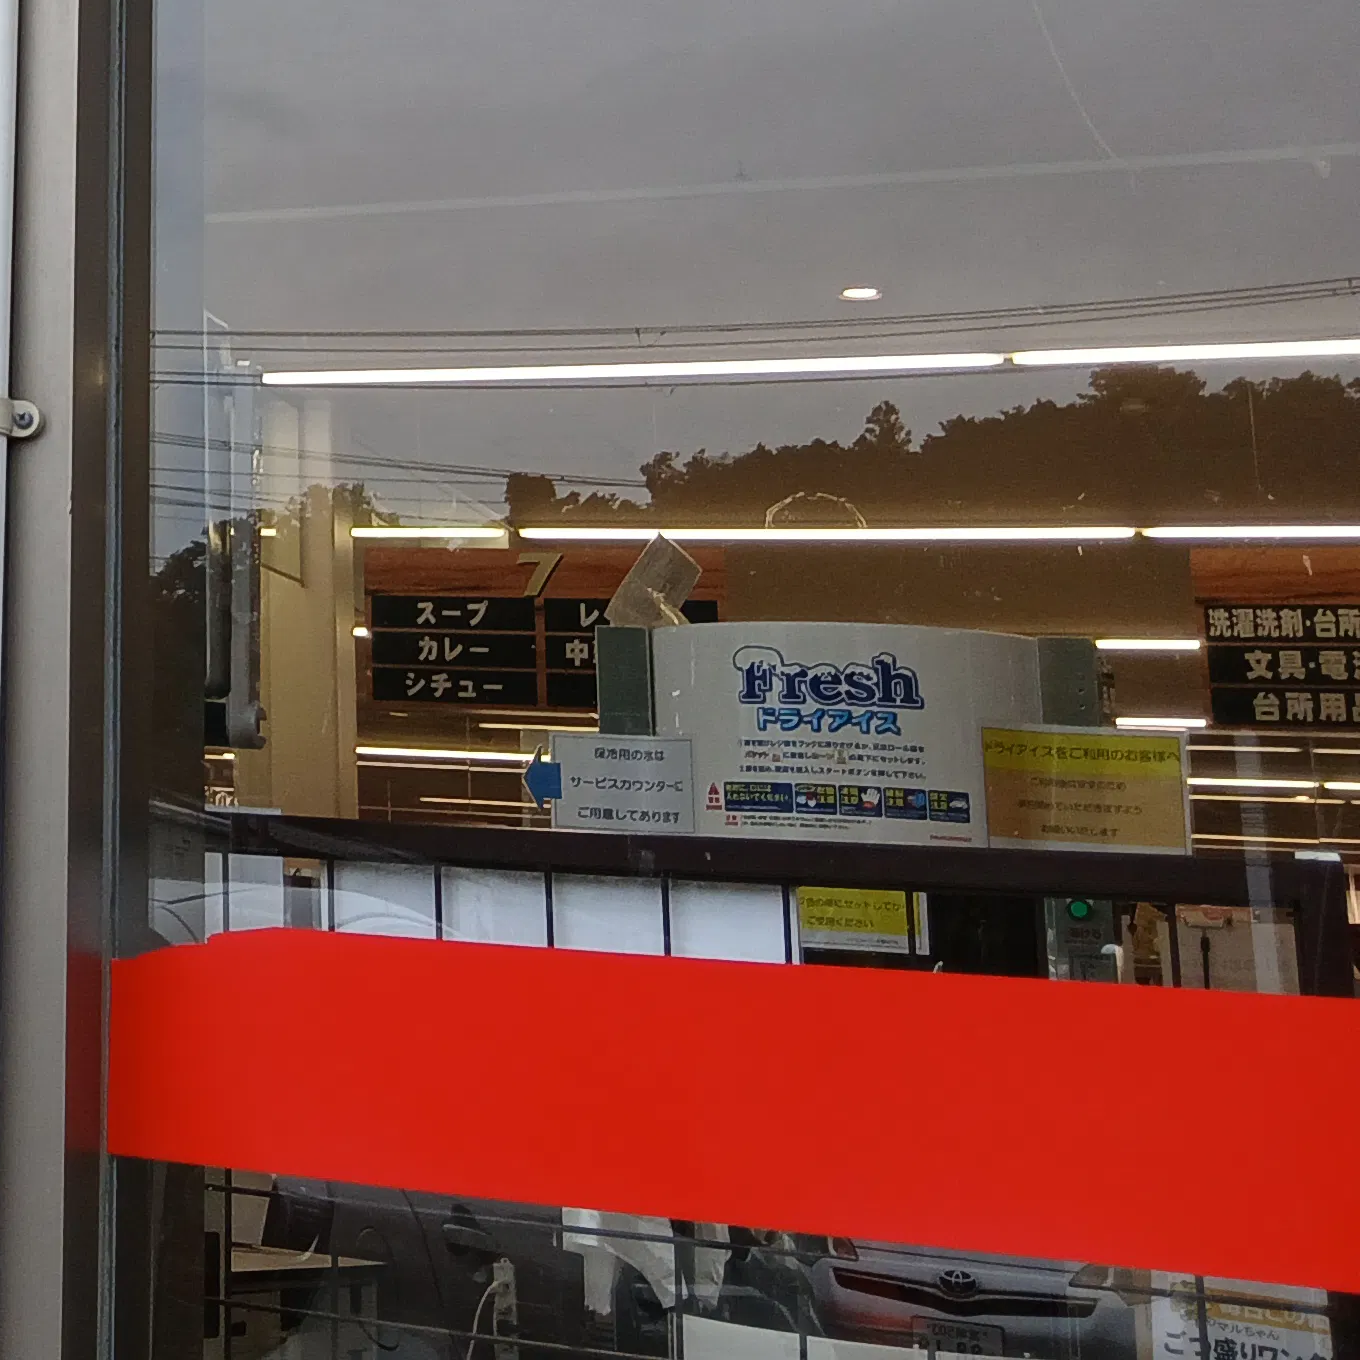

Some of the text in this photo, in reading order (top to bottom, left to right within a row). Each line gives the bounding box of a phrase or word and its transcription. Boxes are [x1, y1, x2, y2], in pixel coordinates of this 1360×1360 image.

[517, 551, 565, 598] 7
[415, 600, 490, 626] スープ
[417, 636, 490, 663] カレー
[565, 640, 597, 667] 中
[405, 672, 504, 698] シチュー
[734, 648, 925, 710] Fresh
[755, 706, 903, 737] ドライアイス
[570, 775, 684, 793] サービスカウンターに
[577, 806, 680, 824] ご用意してあります
